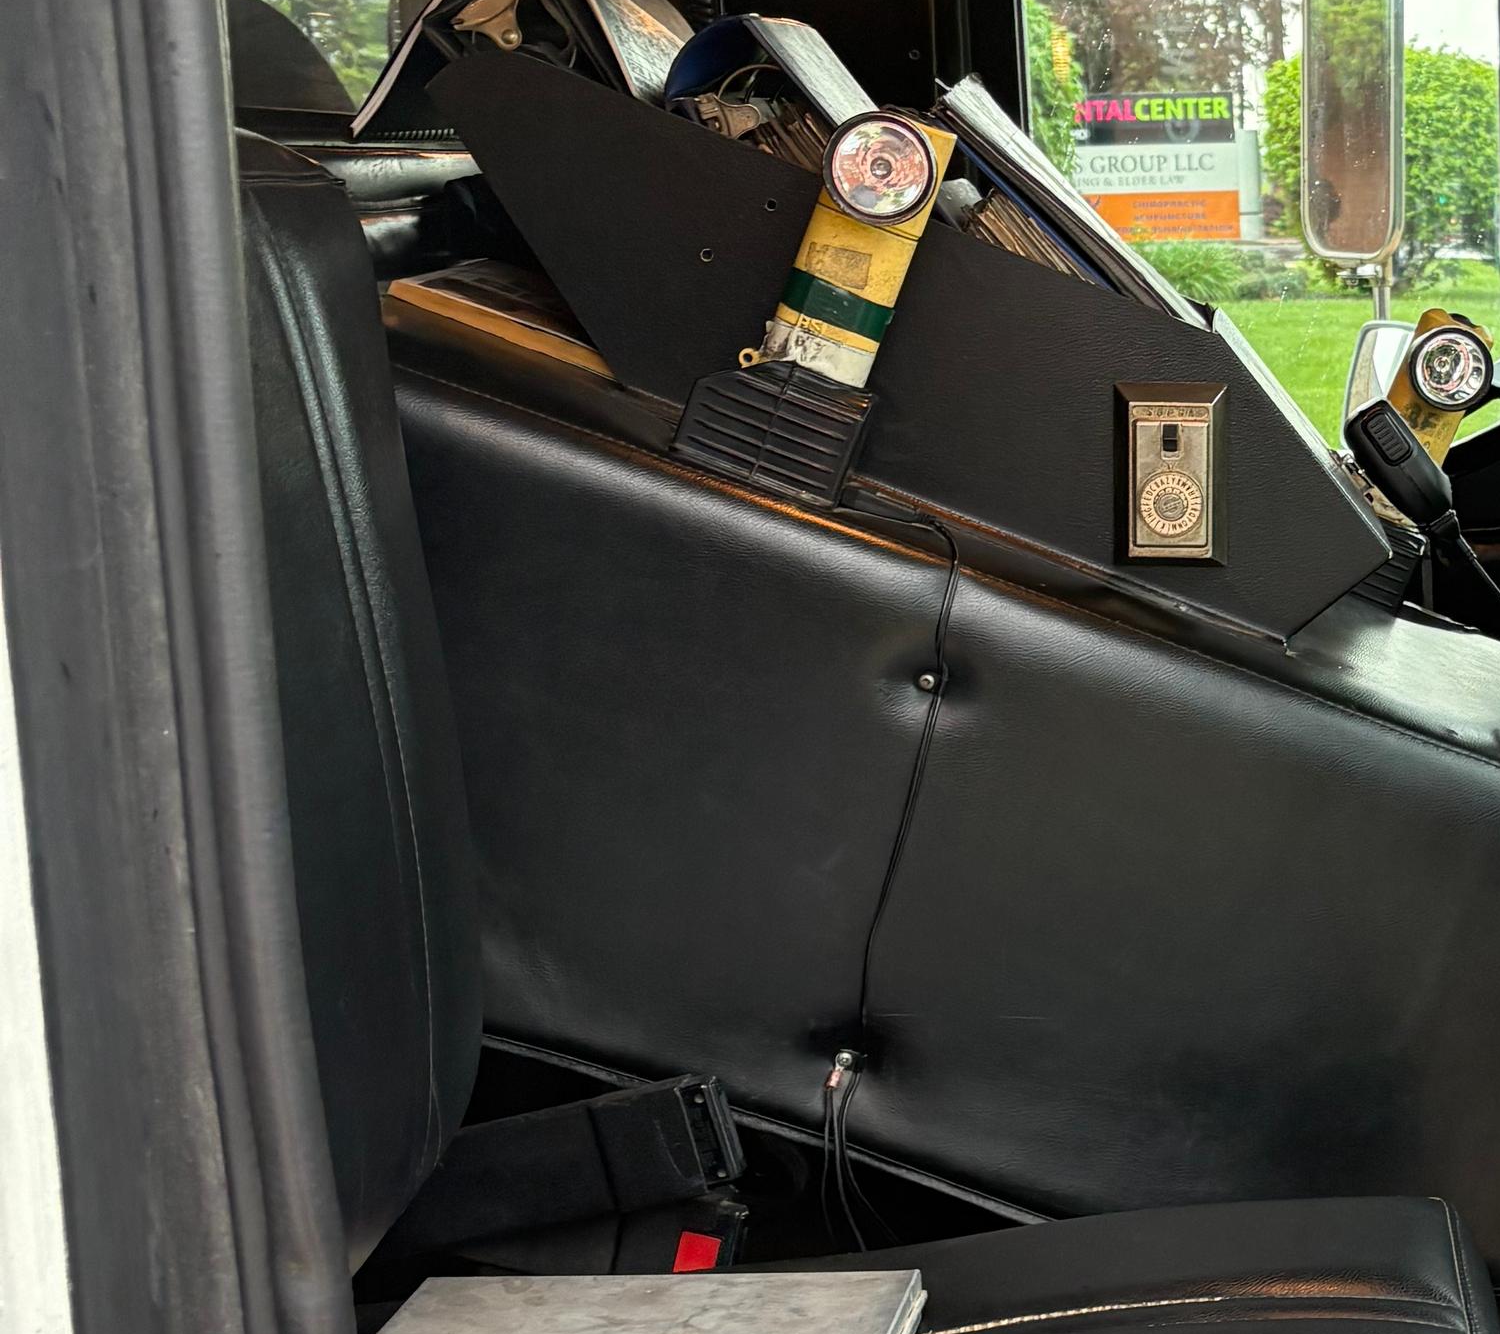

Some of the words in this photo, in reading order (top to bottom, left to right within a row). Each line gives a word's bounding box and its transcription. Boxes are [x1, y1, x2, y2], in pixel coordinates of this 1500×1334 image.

[1089, 154, 1168, 175] GROUP
[1174, 153, 1216, 172] LLC
[1160, 174, 1186, 186] LAW
